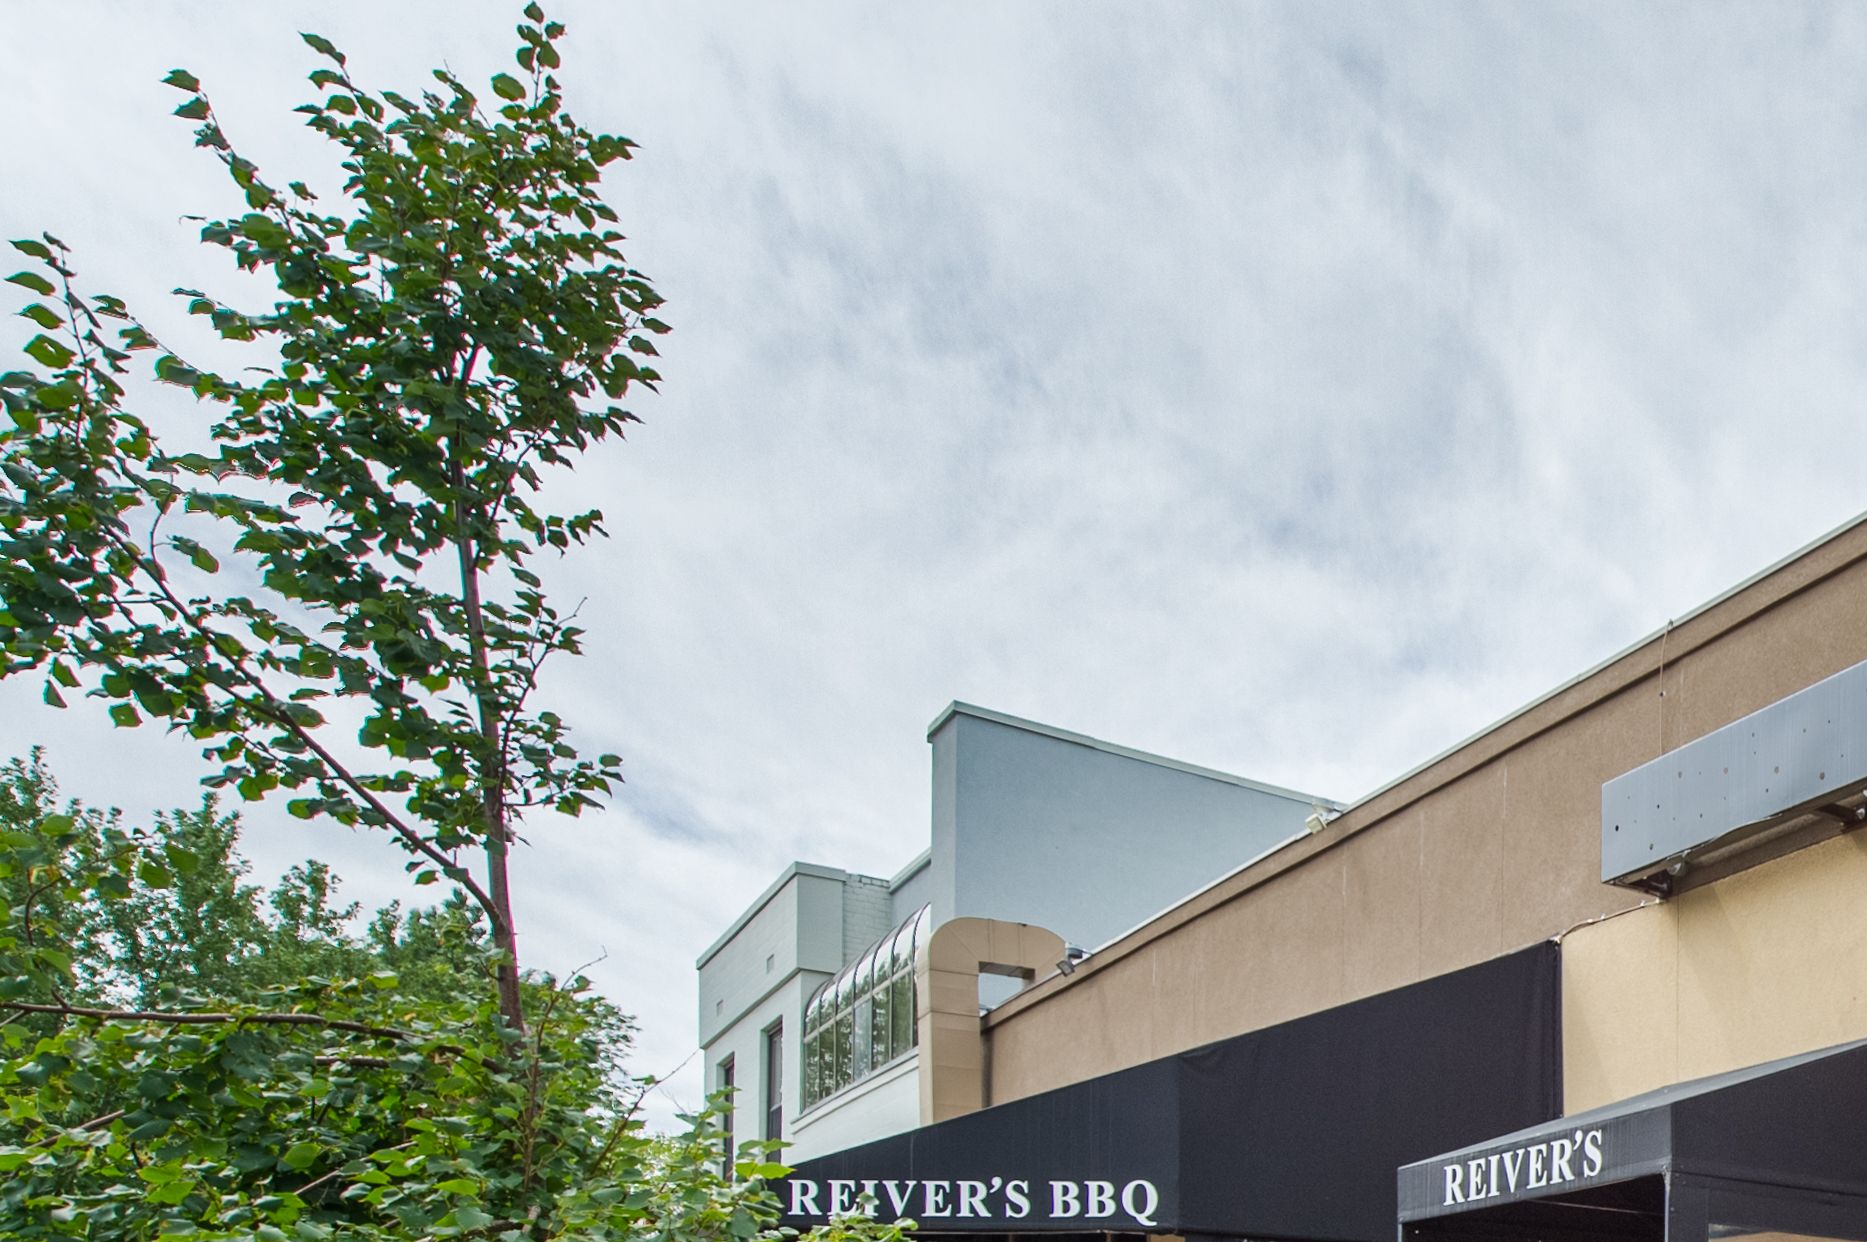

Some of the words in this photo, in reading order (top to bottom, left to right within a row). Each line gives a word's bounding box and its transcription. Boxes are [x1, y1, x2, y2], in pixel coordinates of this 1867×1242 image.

[1443, 1129, 1603, 1206] REIVER'S
[787, 1176, 1031, 1219] REIVER'S
[1048, 1179, 1159, 1227] BBQ
